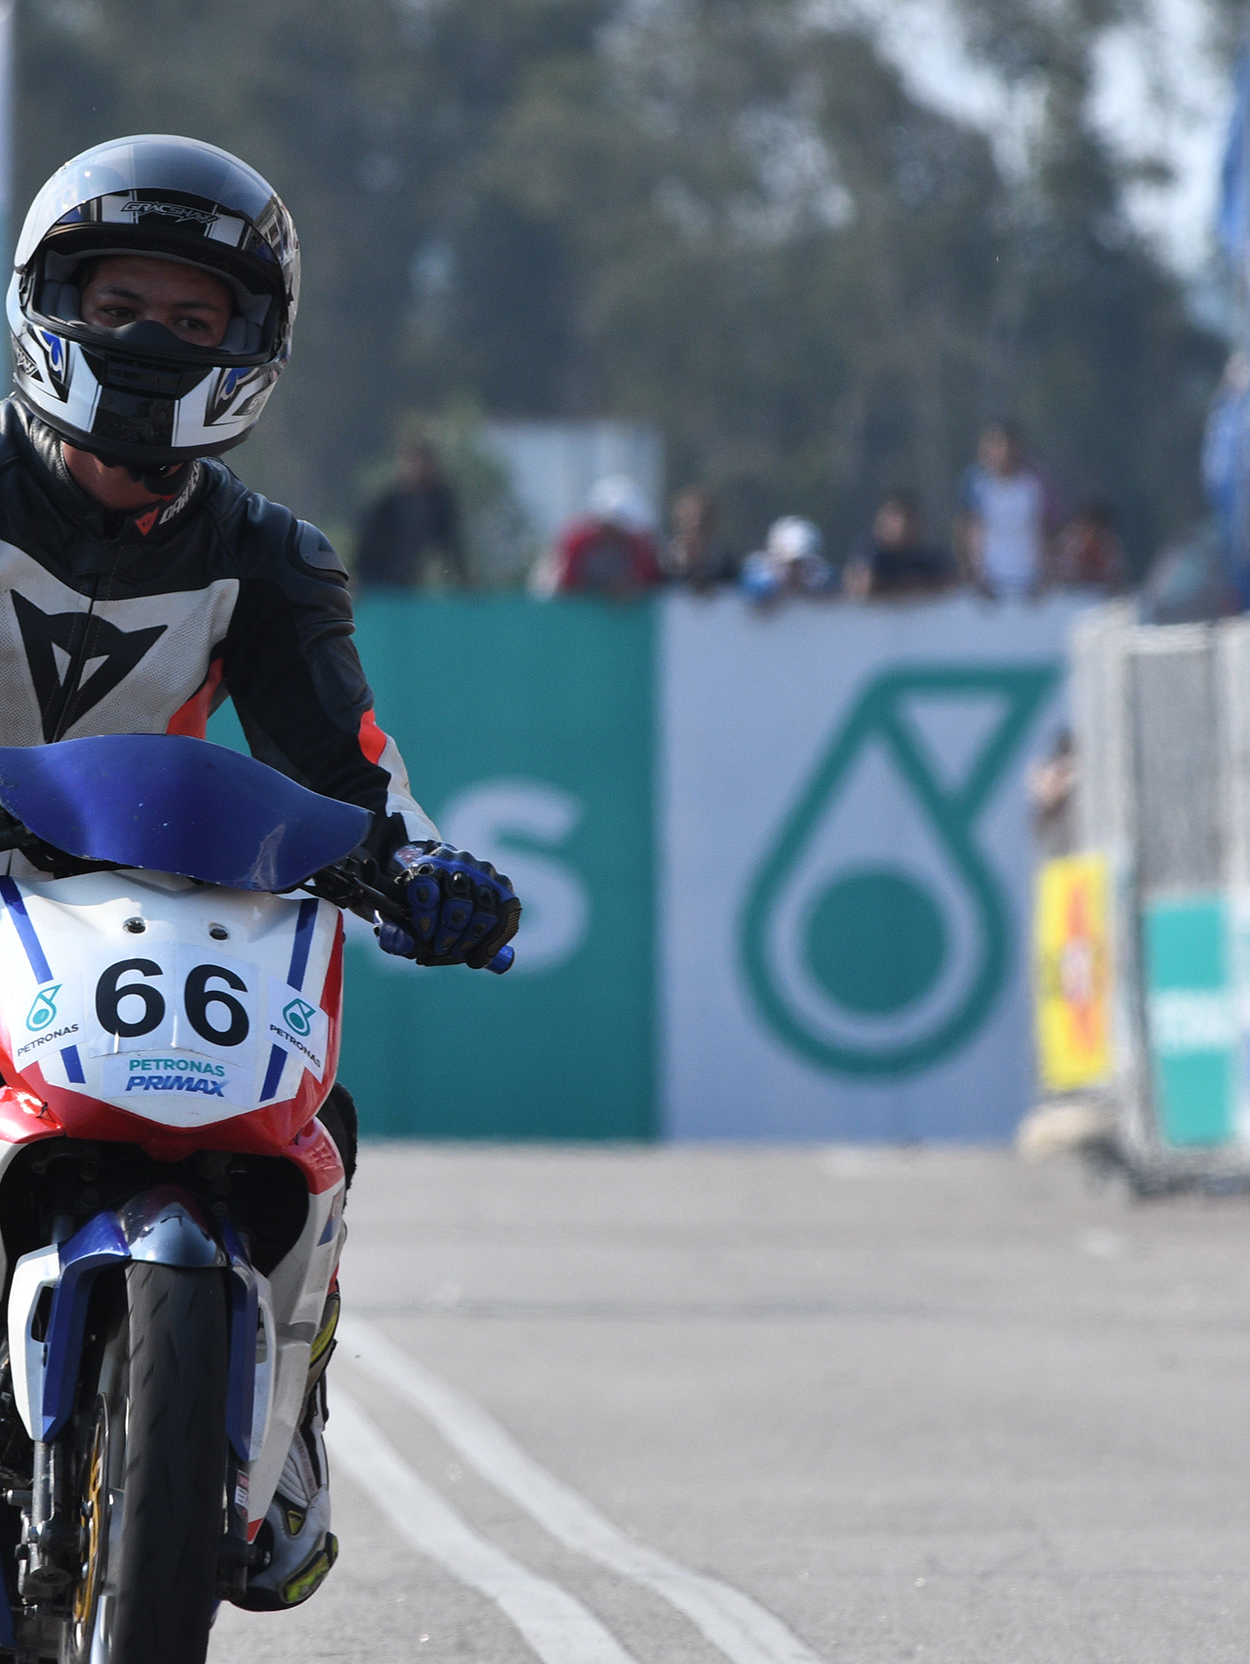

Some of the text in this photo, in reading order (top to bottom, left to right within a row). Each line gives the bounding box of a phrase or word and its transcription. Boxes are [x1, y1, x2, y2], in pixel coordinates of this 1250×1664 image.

[95, 957, 250, 1047] 66
[17, 1023, 80, 1057] PETRONAS
[270, 1024, 321, 1068] PETRONAS
[129, 1059, 225, 1077] PETRONAS
[125, 1075, 230, 1097] PRIMAX
